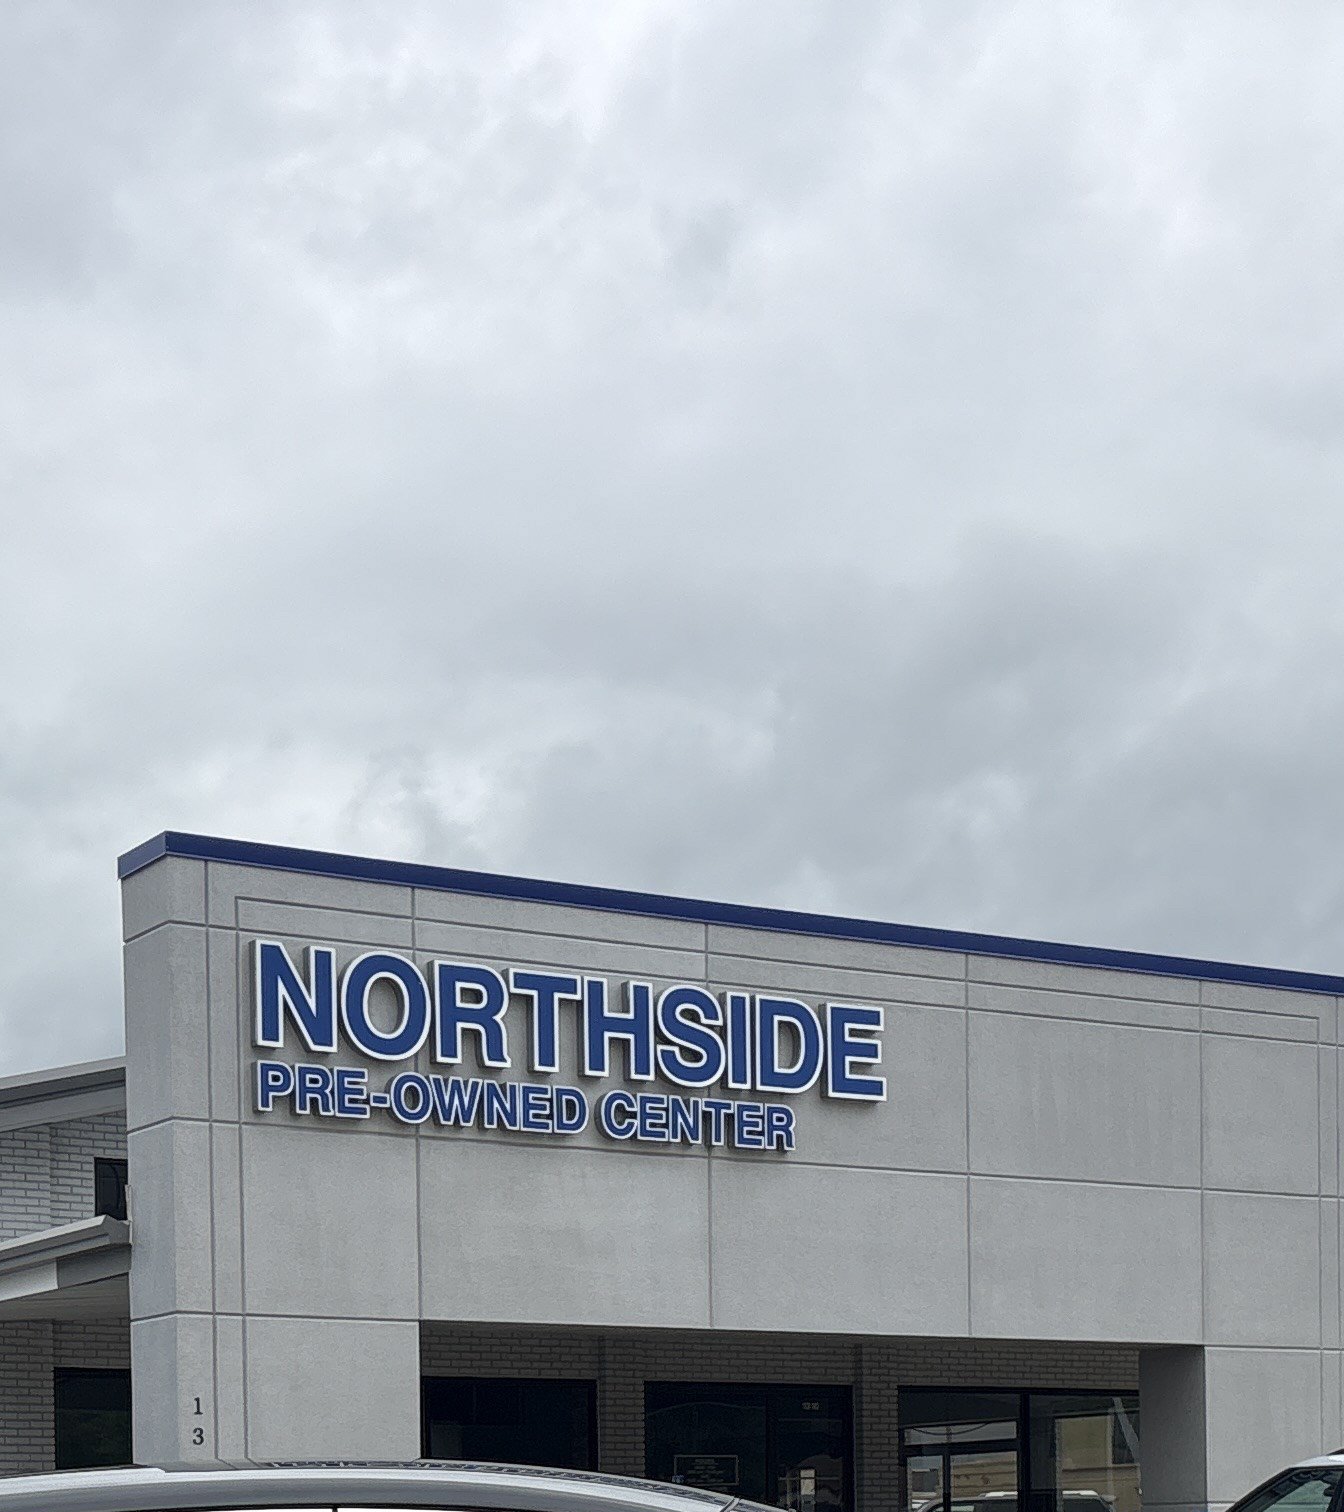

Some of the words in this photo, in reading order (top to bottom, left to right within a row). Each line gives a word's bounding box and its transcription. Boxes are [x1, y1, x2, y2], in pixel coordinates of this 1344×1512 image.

[253, 938, 887, 1101] NORTHSIDE
[258, 1061, 588, 1134] PRE-OWNED
[601, 1093, 796, 1151] CENTER
